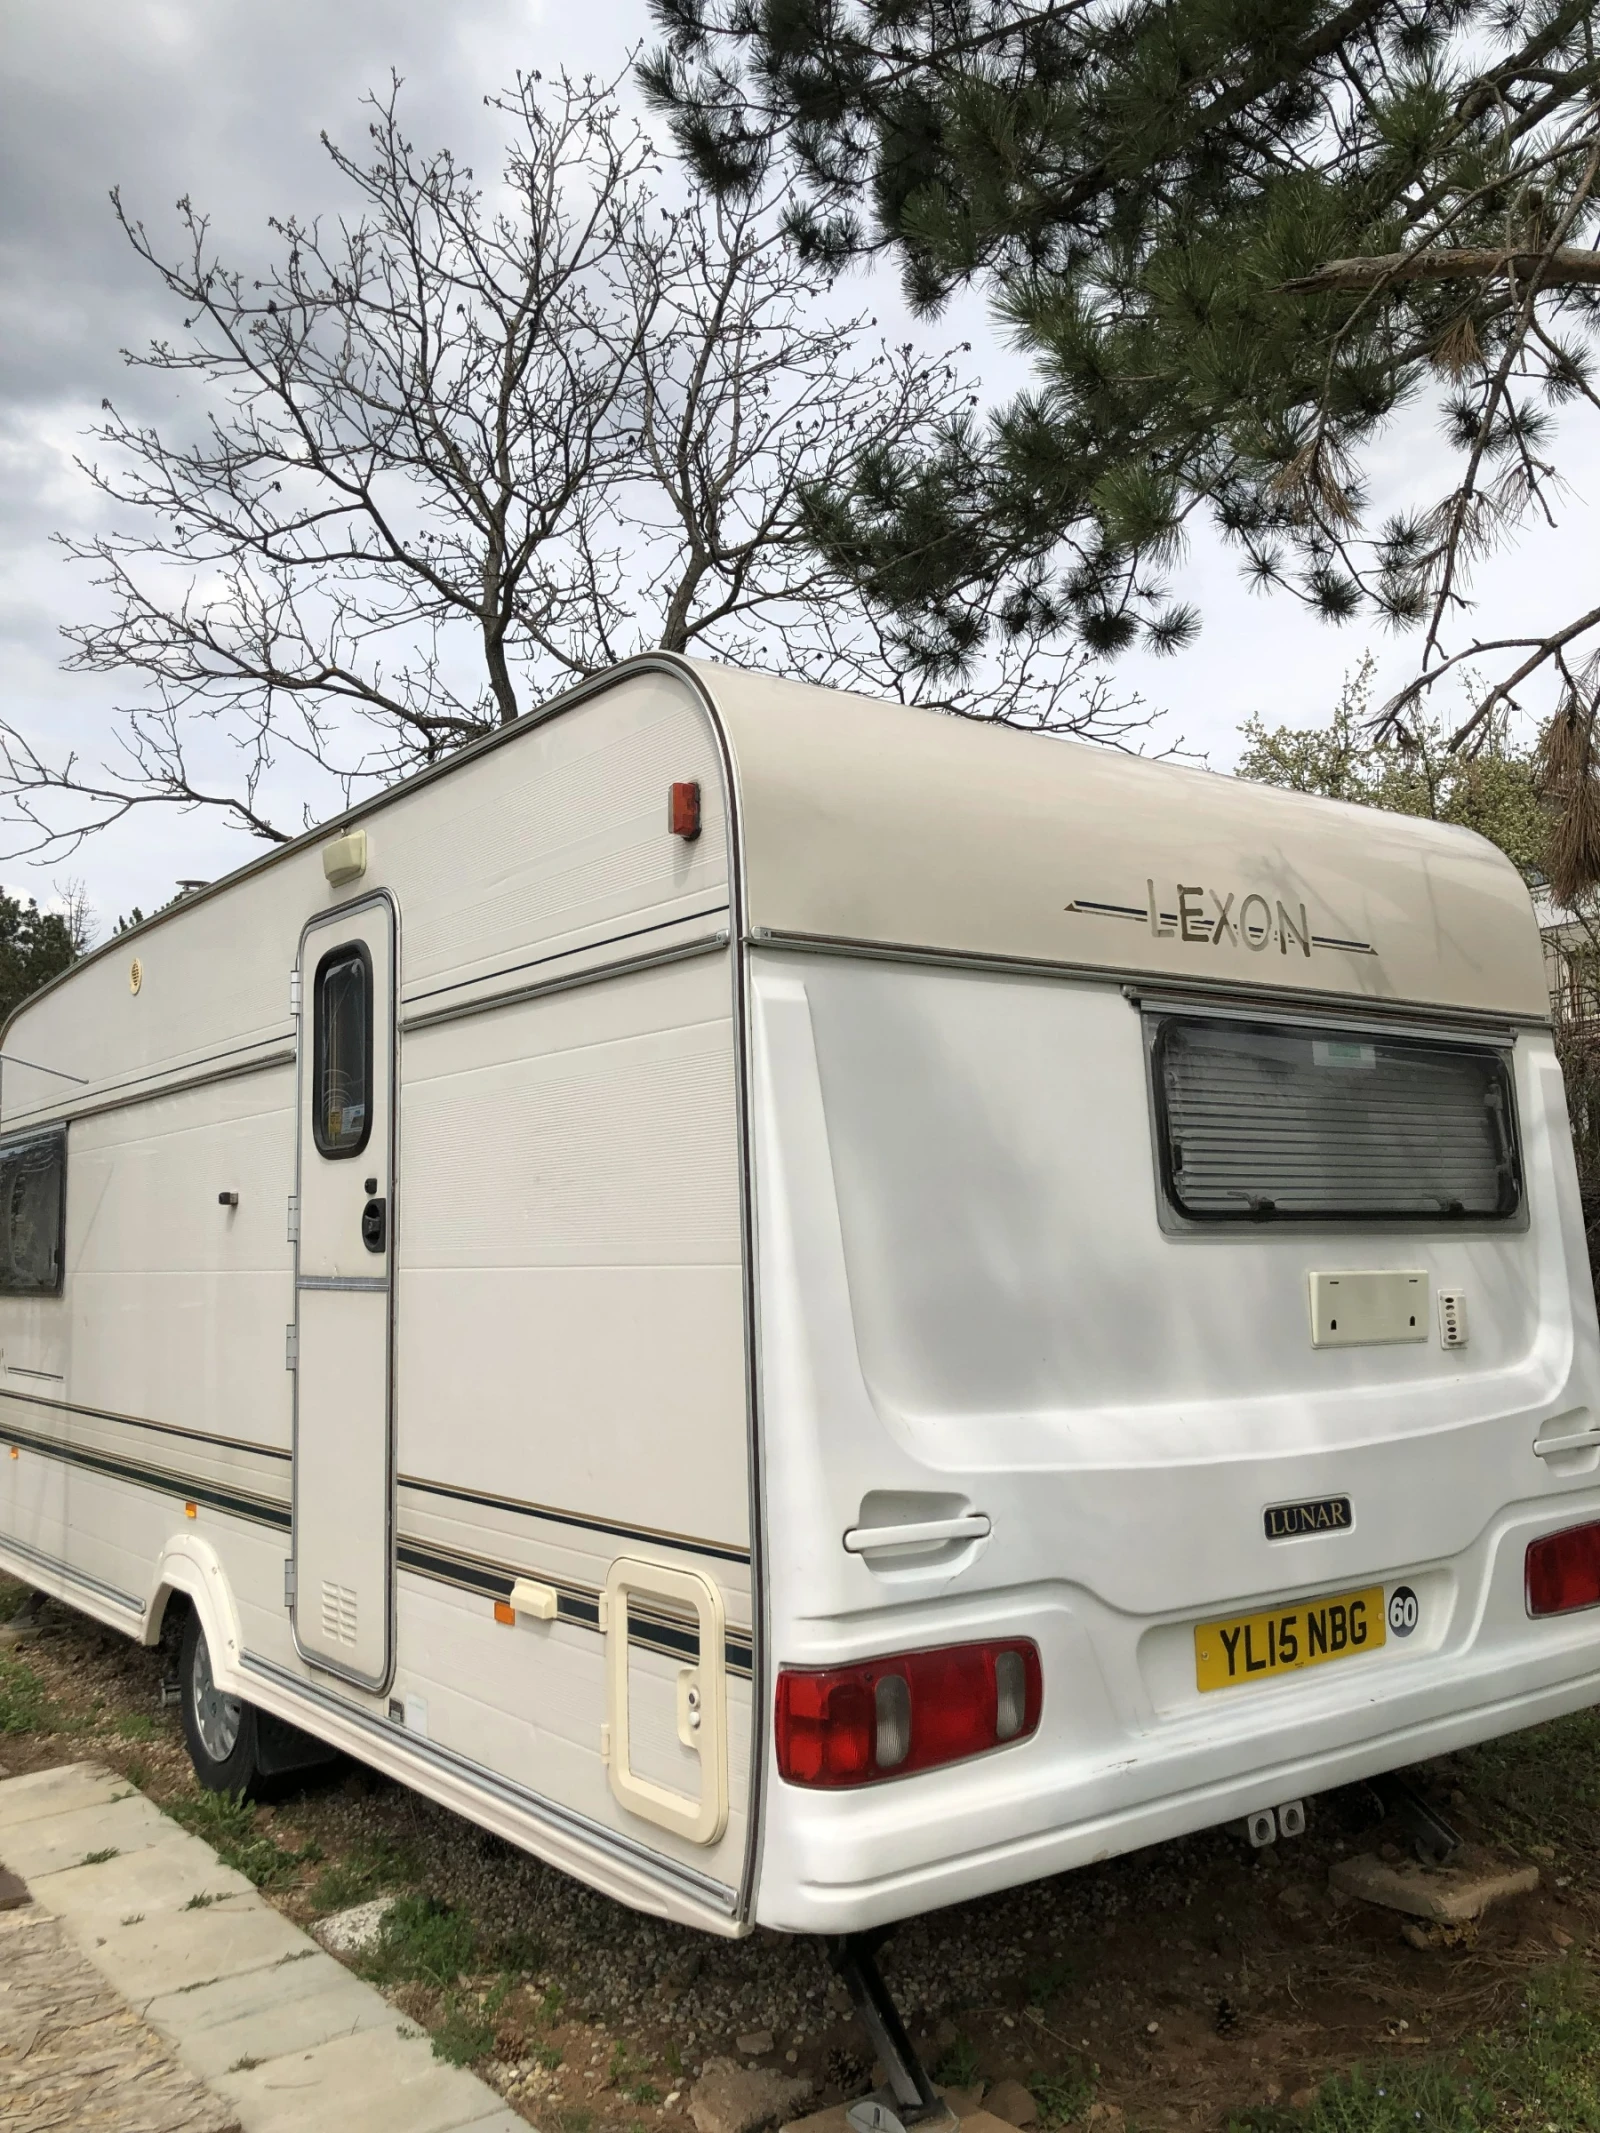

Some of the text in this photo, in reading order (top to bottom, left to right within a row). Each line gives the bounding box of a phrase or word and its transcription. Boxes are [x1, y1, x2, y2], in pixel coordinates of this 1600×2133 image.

[1146, 879, 1311, 957] LEXON
[1270, 1502, 1346, 1535] LUNAR
[1220, 1600, 1367, 1676] YL15 NBG
[1389, 1596, 1418, 1628] 60
